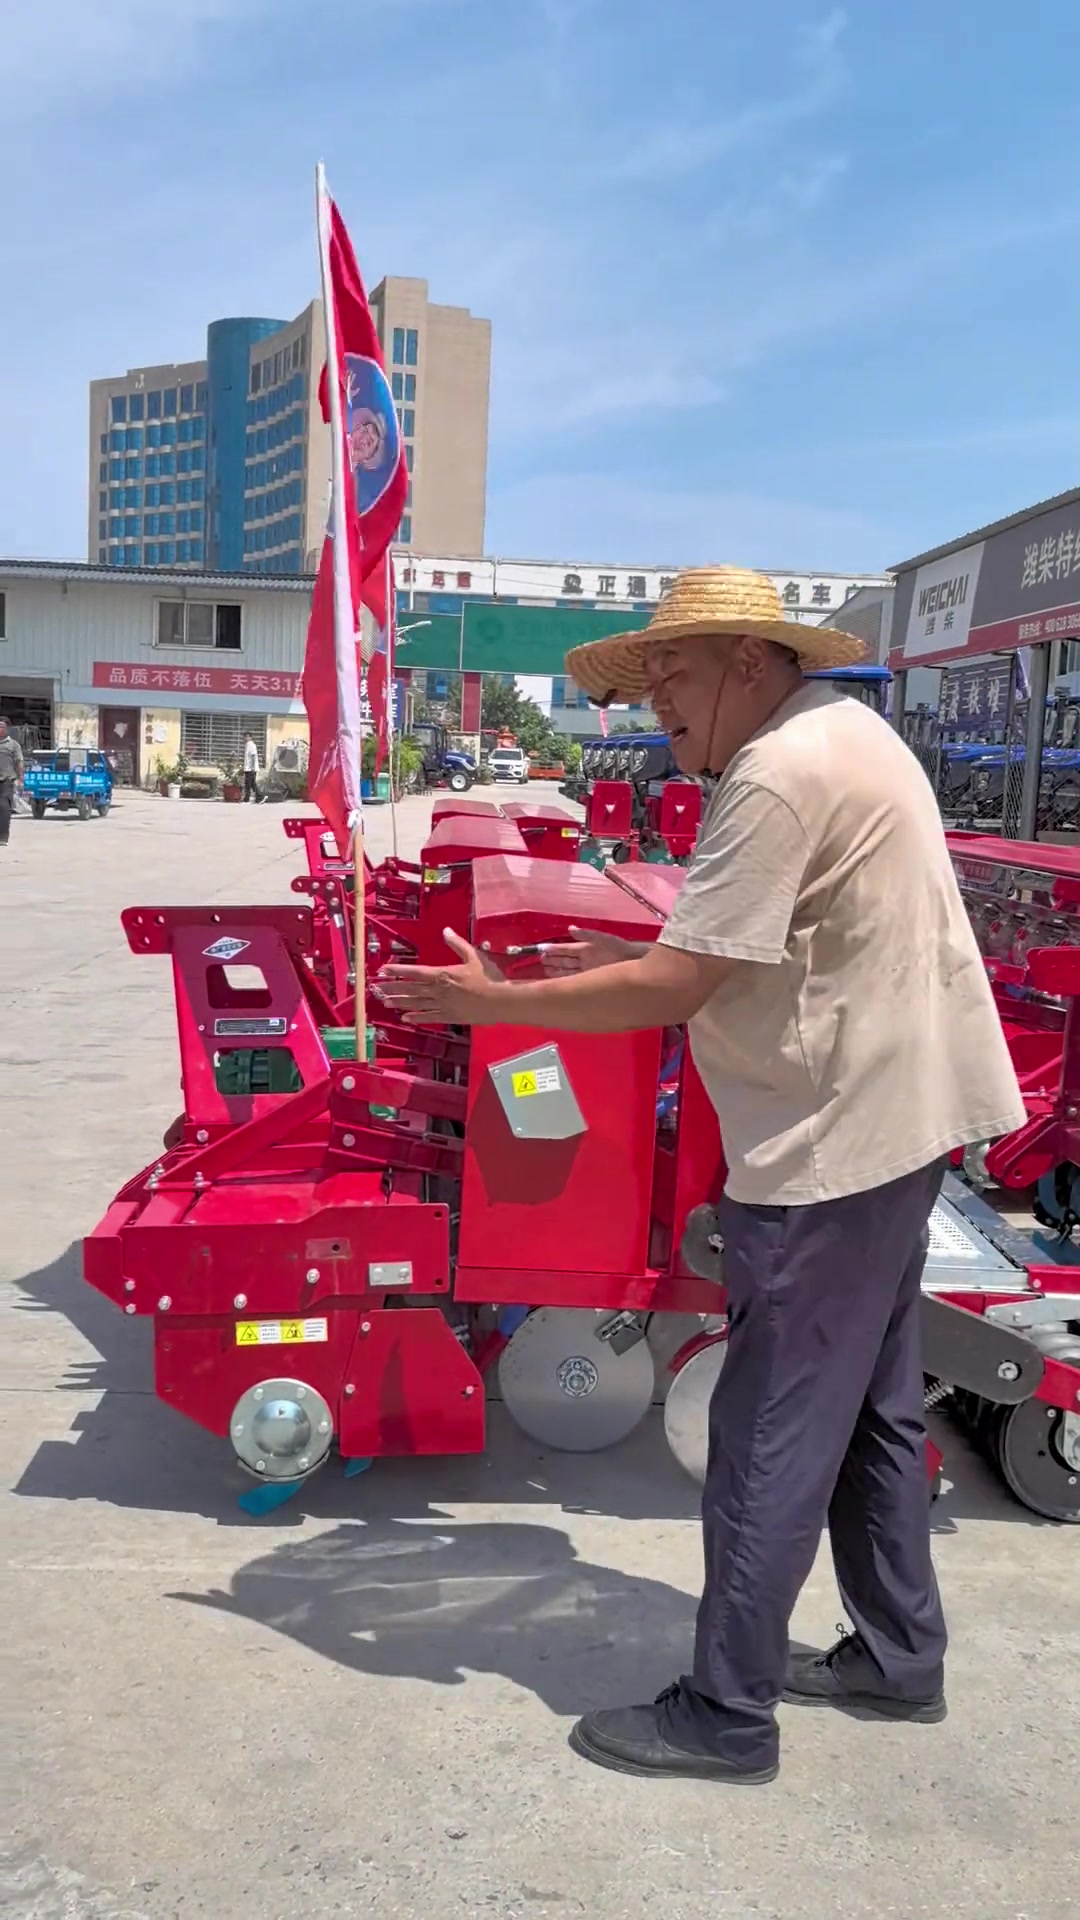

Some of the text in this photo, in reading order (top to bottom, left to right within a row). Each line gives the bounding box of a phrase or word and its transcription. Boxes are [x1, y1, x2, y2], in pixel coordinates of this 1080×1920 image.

[918, 573, 970, 617] WEICHAI
[109, 667, 304, 693] 品质不落伍 天天3.15
